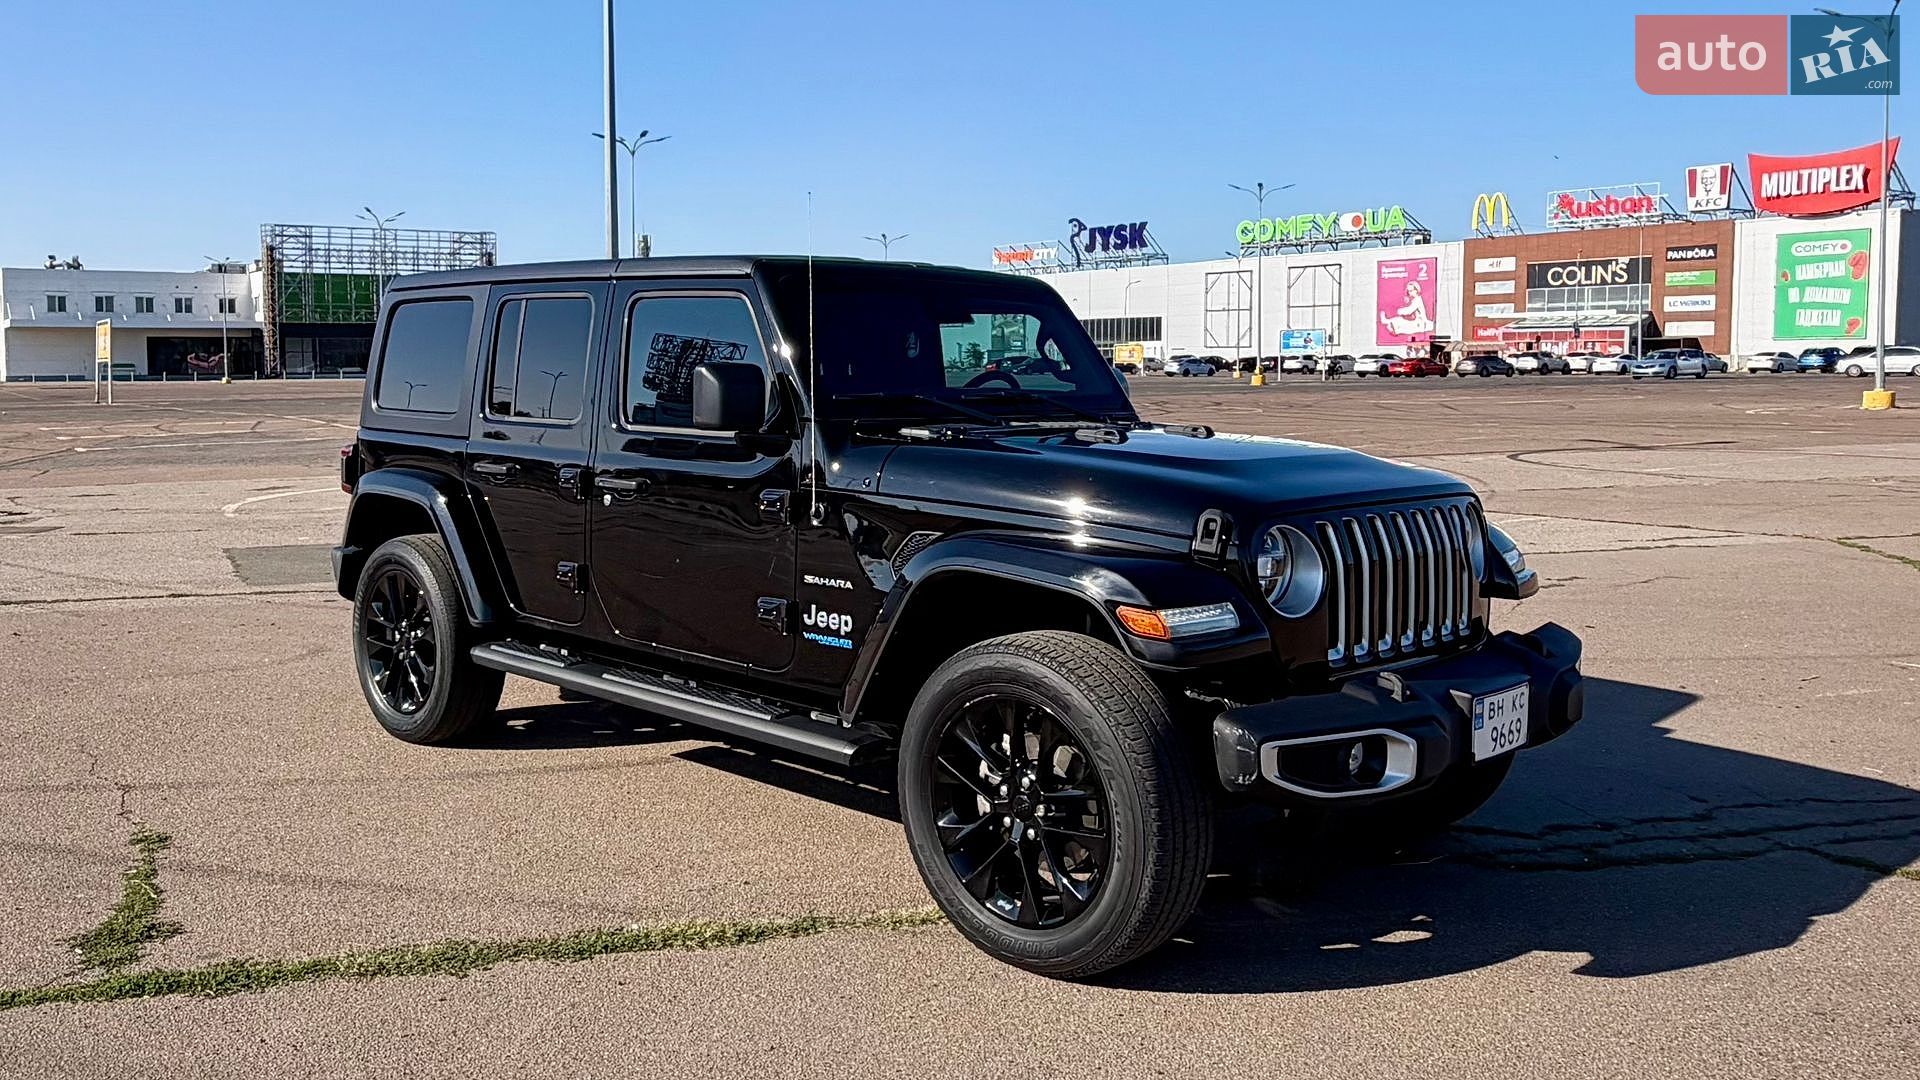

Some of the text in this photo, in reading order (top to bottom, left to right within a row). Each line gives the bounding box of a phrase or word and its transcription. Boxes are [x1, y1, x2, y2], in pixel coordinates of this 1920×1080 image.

[1761, 164, 1866, 199] MULTIPLEX
[1694, 197, 1722, 209] KFC
[1084, 221, 1149, 253] JYSK
[1236, 205, 1408, 244] COMFY UA
[1667, 248, 1715, 260] PANDORA
[1794, 243, 1838, 253] COMFY
[1418, 263, 1428, 277] 2
[1547, 260, 1629, 286] COLIN'S
[803, 575, 854, 590] SAHARA
[803, 604, 853, 636] Jeep
[1488, 691, 1525, 720] BH KC
[1491, 718, 1522, 753] 9669
